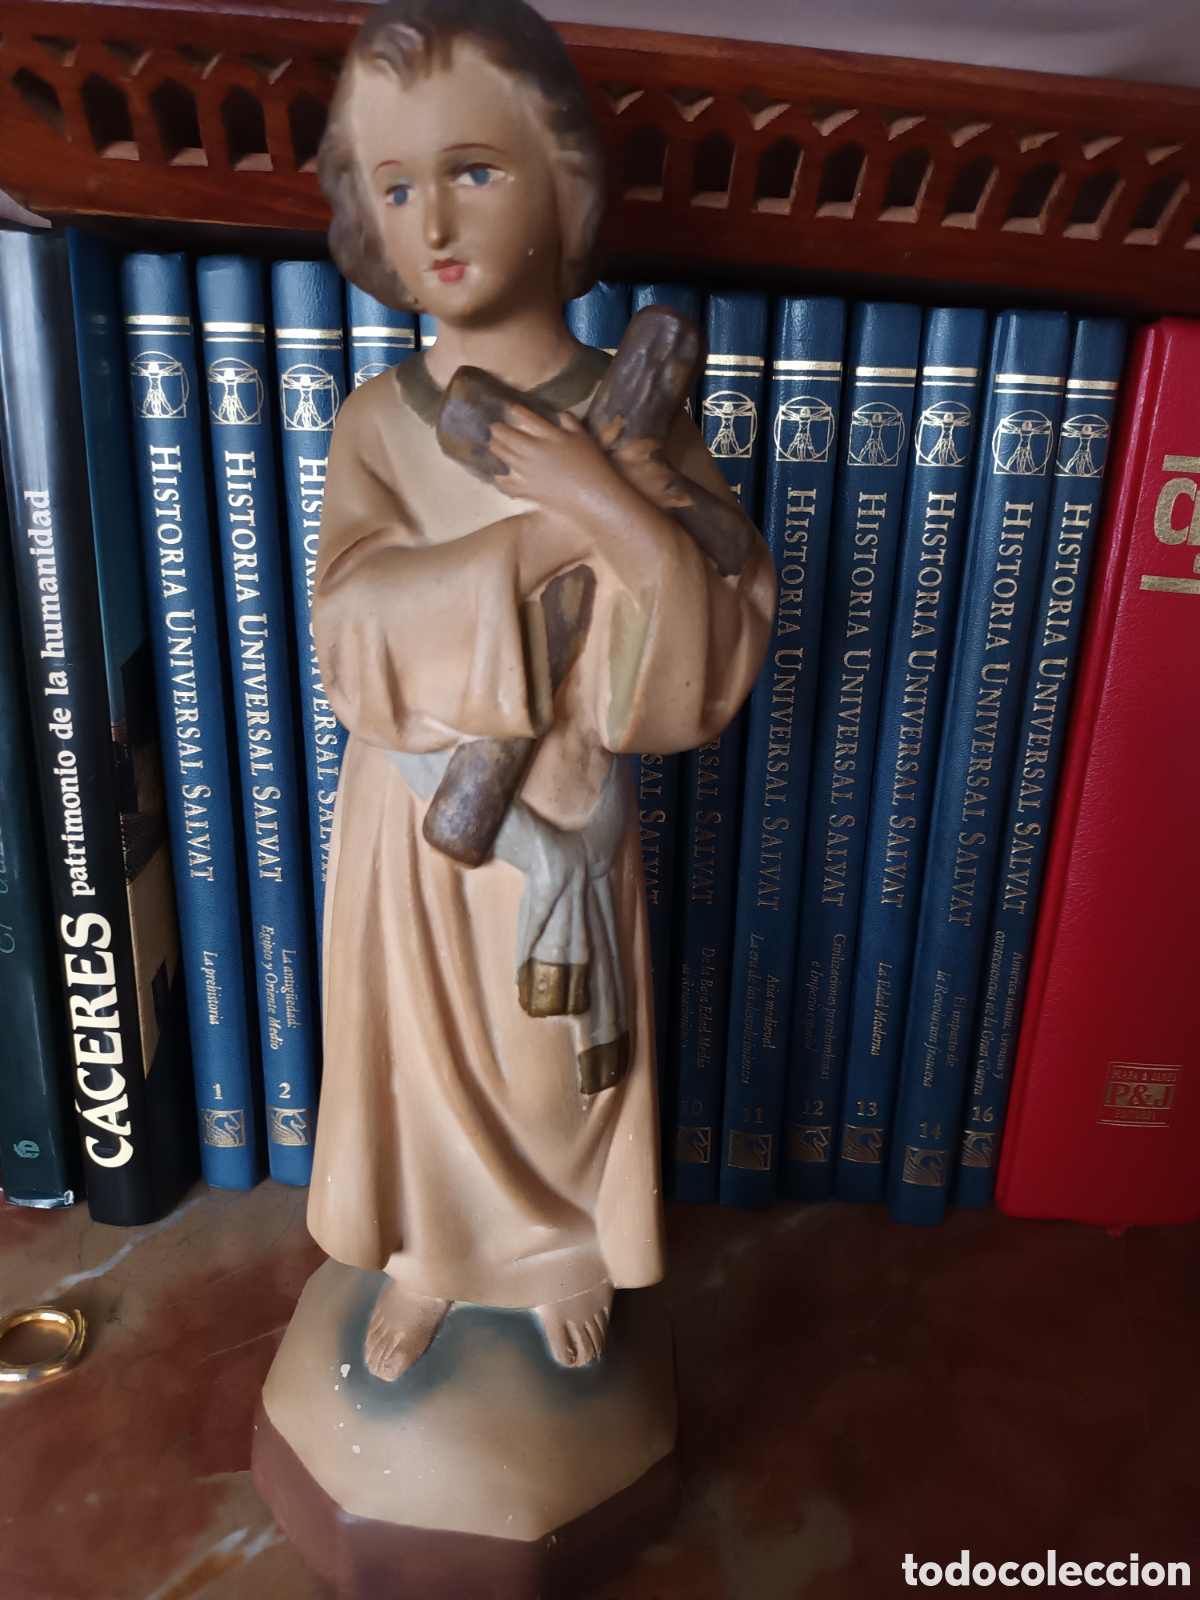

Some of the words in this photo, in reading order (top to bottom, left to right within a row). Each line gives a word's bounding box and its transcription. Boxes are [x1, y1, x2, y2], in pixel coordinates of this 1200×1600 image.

[150, 445, 187, 598] HISTORIA
[225, 451, 259, 602] HISTORIA
[24, 490, 66, 659] humanidad
[777, 487, 817, 637] HISTORIA
[846, 491, 887, 638] HISTORIA
[911, 490, 957, 639] HISTORIA
[984, 502, 1034, 650] HISTORIA
[1043, 502, 1092, 648] HISTORIA
[45, 671, 69, 697] la
[165, 609, 203, 775] UNIVERSAL
[238, 614, 274, 777] UNIVERSAL
[48, 707, 72, 740] de
[764, 647, 803, 806] UNIVERSAL
[832, 647, 871, 804] UNIVERSAL
[891, 648, 938, 805] UNIVERSAL
[960, 662, 1011, 823] UNIVERSAL
[1016, 657, 1068, 813] UNIVERSAL
[53, 748, 97, 897] patrimonio
[181, 784, 214, 882] SALVAT
[251, 786, 282, 882] SALVAT
[692, 811, 722, 905] SALVAT
[757, 817, 789, 911] SALVAT
[822, 815, 855, 907] SALVAT
[881, 815, 917, 908] SALVAT
[949, 830, 986, 926] SALVAT
[1003, 822, 1042, 915] SALVAT
[203, 950, 218, 966] La
[259, 925, 276, 961] Egipto
[281, 949, 297, 964] La
[701, 946, 716, 963] De
[749, 932, 764, 948] La
[749, 950, 760, 968] era
[261, 961, 273, 971] y
[700, 965, 716, 976] la
[747, 970, 762, 982] de
[766, 974, 780, 998] Asia
[827, 933, 847, 1006] Civilizaciones
[878, 962, 892, 976] La
[936, 970, 952, 981] la
[986, 930, 1006, 1001] consecuencias
[201, 966, 223, 1025] prehistoria
[264, 973, 279, 1014] Oriente
[696, 978, 714, 1003] Baja
[746, 985, 761, 1000] los
[806, 969, 824, 1011] Imperio
[876, 979, 891, 1008] Edad
[953, 996, 967, 1008] El
[984, 1002, 999, 1014] de
[268, 1016, 283, 1051] Medio
[698, 1004, 713, 1033] Edad
[762, 1000, 778, 1050] medieval
[870, 1009, 888, 1056] Moderna
[928, 983, 949, 1044] Revolución
[946, 1010, 963, 1051] impacto
[982, 1016, 998, 1027] la
[61, 911, 134, 1169] CÁCERES
[696, 1035, 711, 1068] Media
[740, 1002, 760, 1085] descubrimientos
[820, 1007, 837, 1080] precolombinas
[945, 1053, 959, 1067] de
[978, 1030, 994, 1057] Gran
[922, 1042, 942, 1088] francesa
[973, 1059, 989, 1097] Guerra
[1112, 1070, 1138, 1080] PLAZA
[213, 1083, 223, 1099] 1
[279, 1082, 291, 1099] 2
[802, 1100, 824, 1115] 12
[857, 1101, 878, 1116] 13
[1108, 1083, 1174, 1108] P&J
[743, 1107, 763, 1123] 11
[920, 1122, 941, 1139] 14
[972, 1105, 994, 1122] 16
